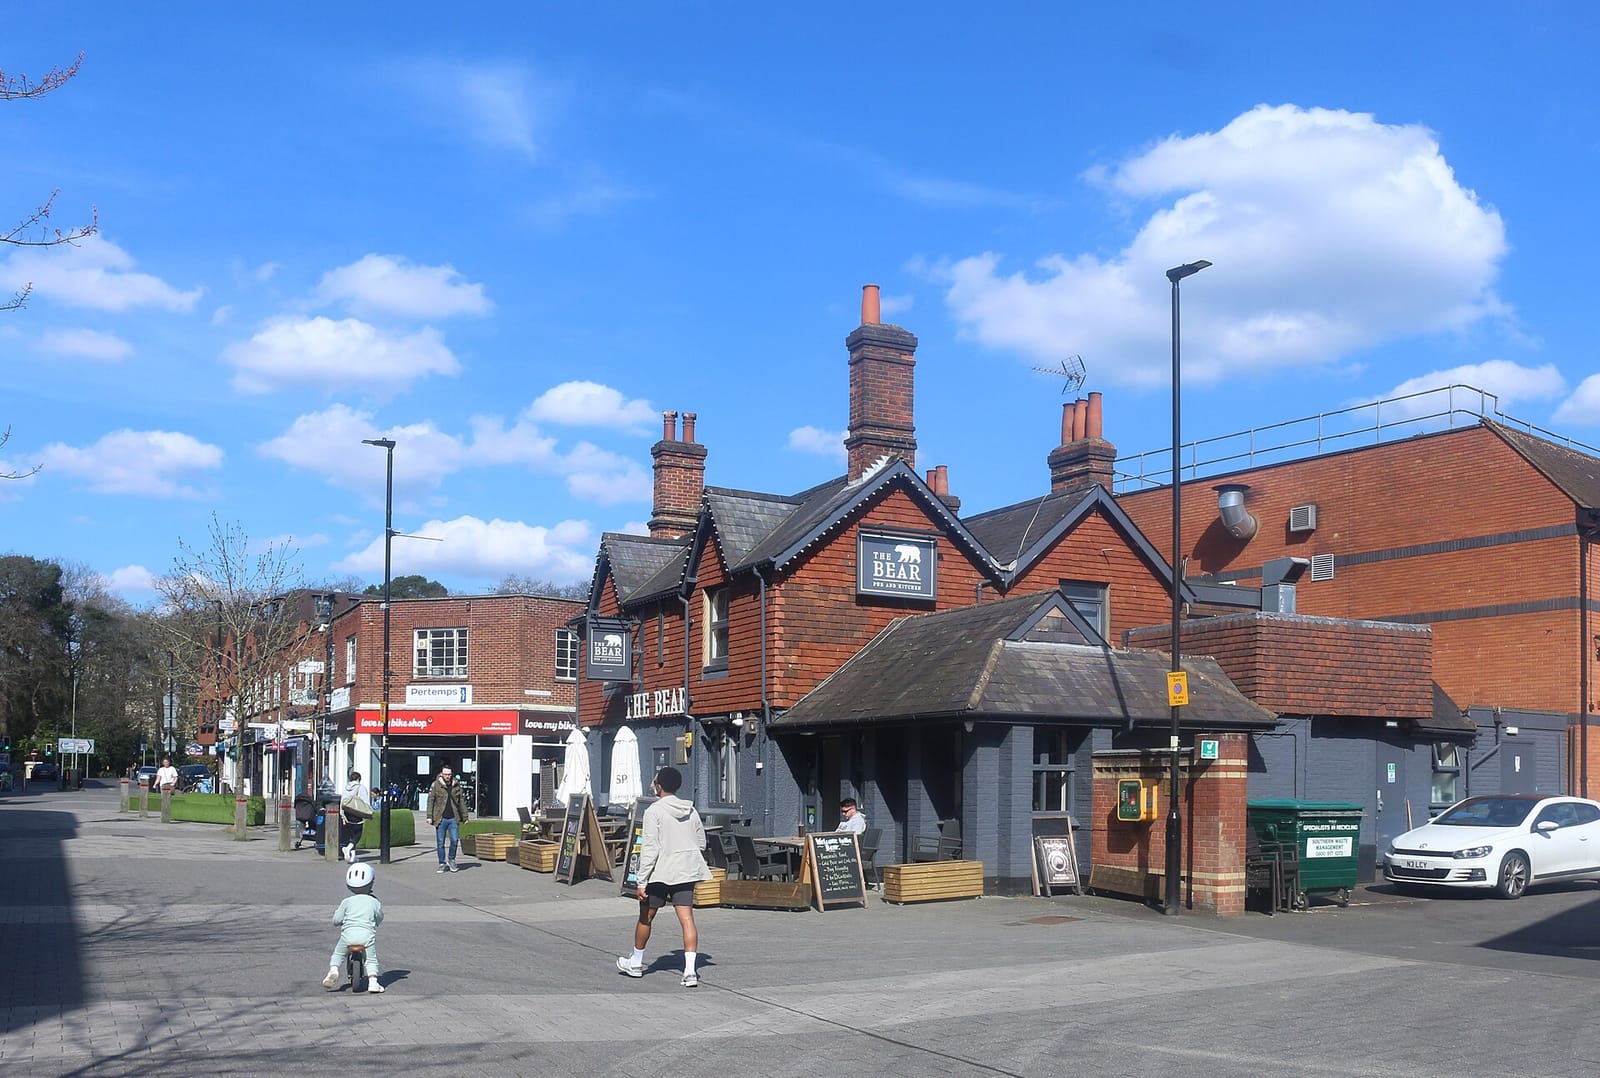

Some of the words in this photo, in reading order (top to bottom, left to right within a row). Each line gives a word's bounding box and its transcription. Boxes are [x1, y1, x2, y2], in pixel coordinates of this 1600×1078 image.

[873, 552, 892, 560] THE
[873, 561, 922, 580] BEAR
[594, 646, 623, 657] BEAR
[411, 688, 458, 697] Pertemps
[624, 692, 650, 719] THE
[524, 719, 541, 729] love
[543, 721, 558, 732] my
[557, 720, 577, 731] bike
